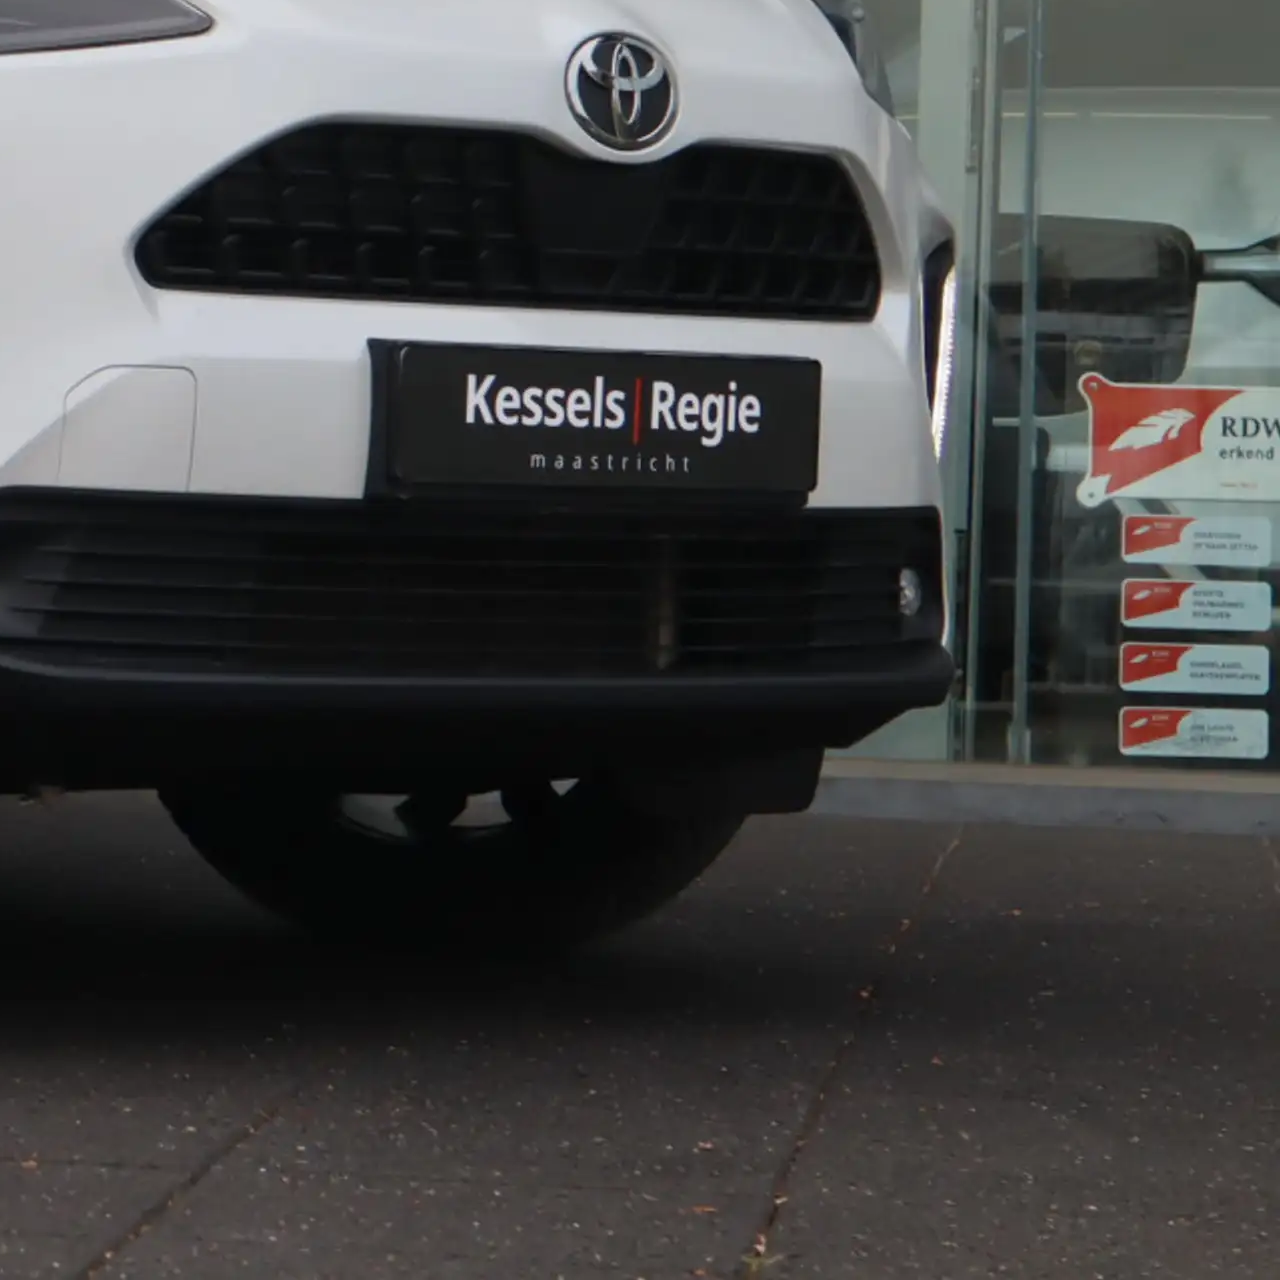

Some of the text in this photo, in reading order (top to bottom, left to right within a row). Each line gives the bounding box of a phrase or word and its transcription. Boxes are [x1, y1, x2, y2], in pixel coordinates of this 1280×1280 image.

[464, 373, 762, 448] Kessels Regie
[529, 452, 691, 473] maastricht
[1219, 445, 1274, 461] erkend
